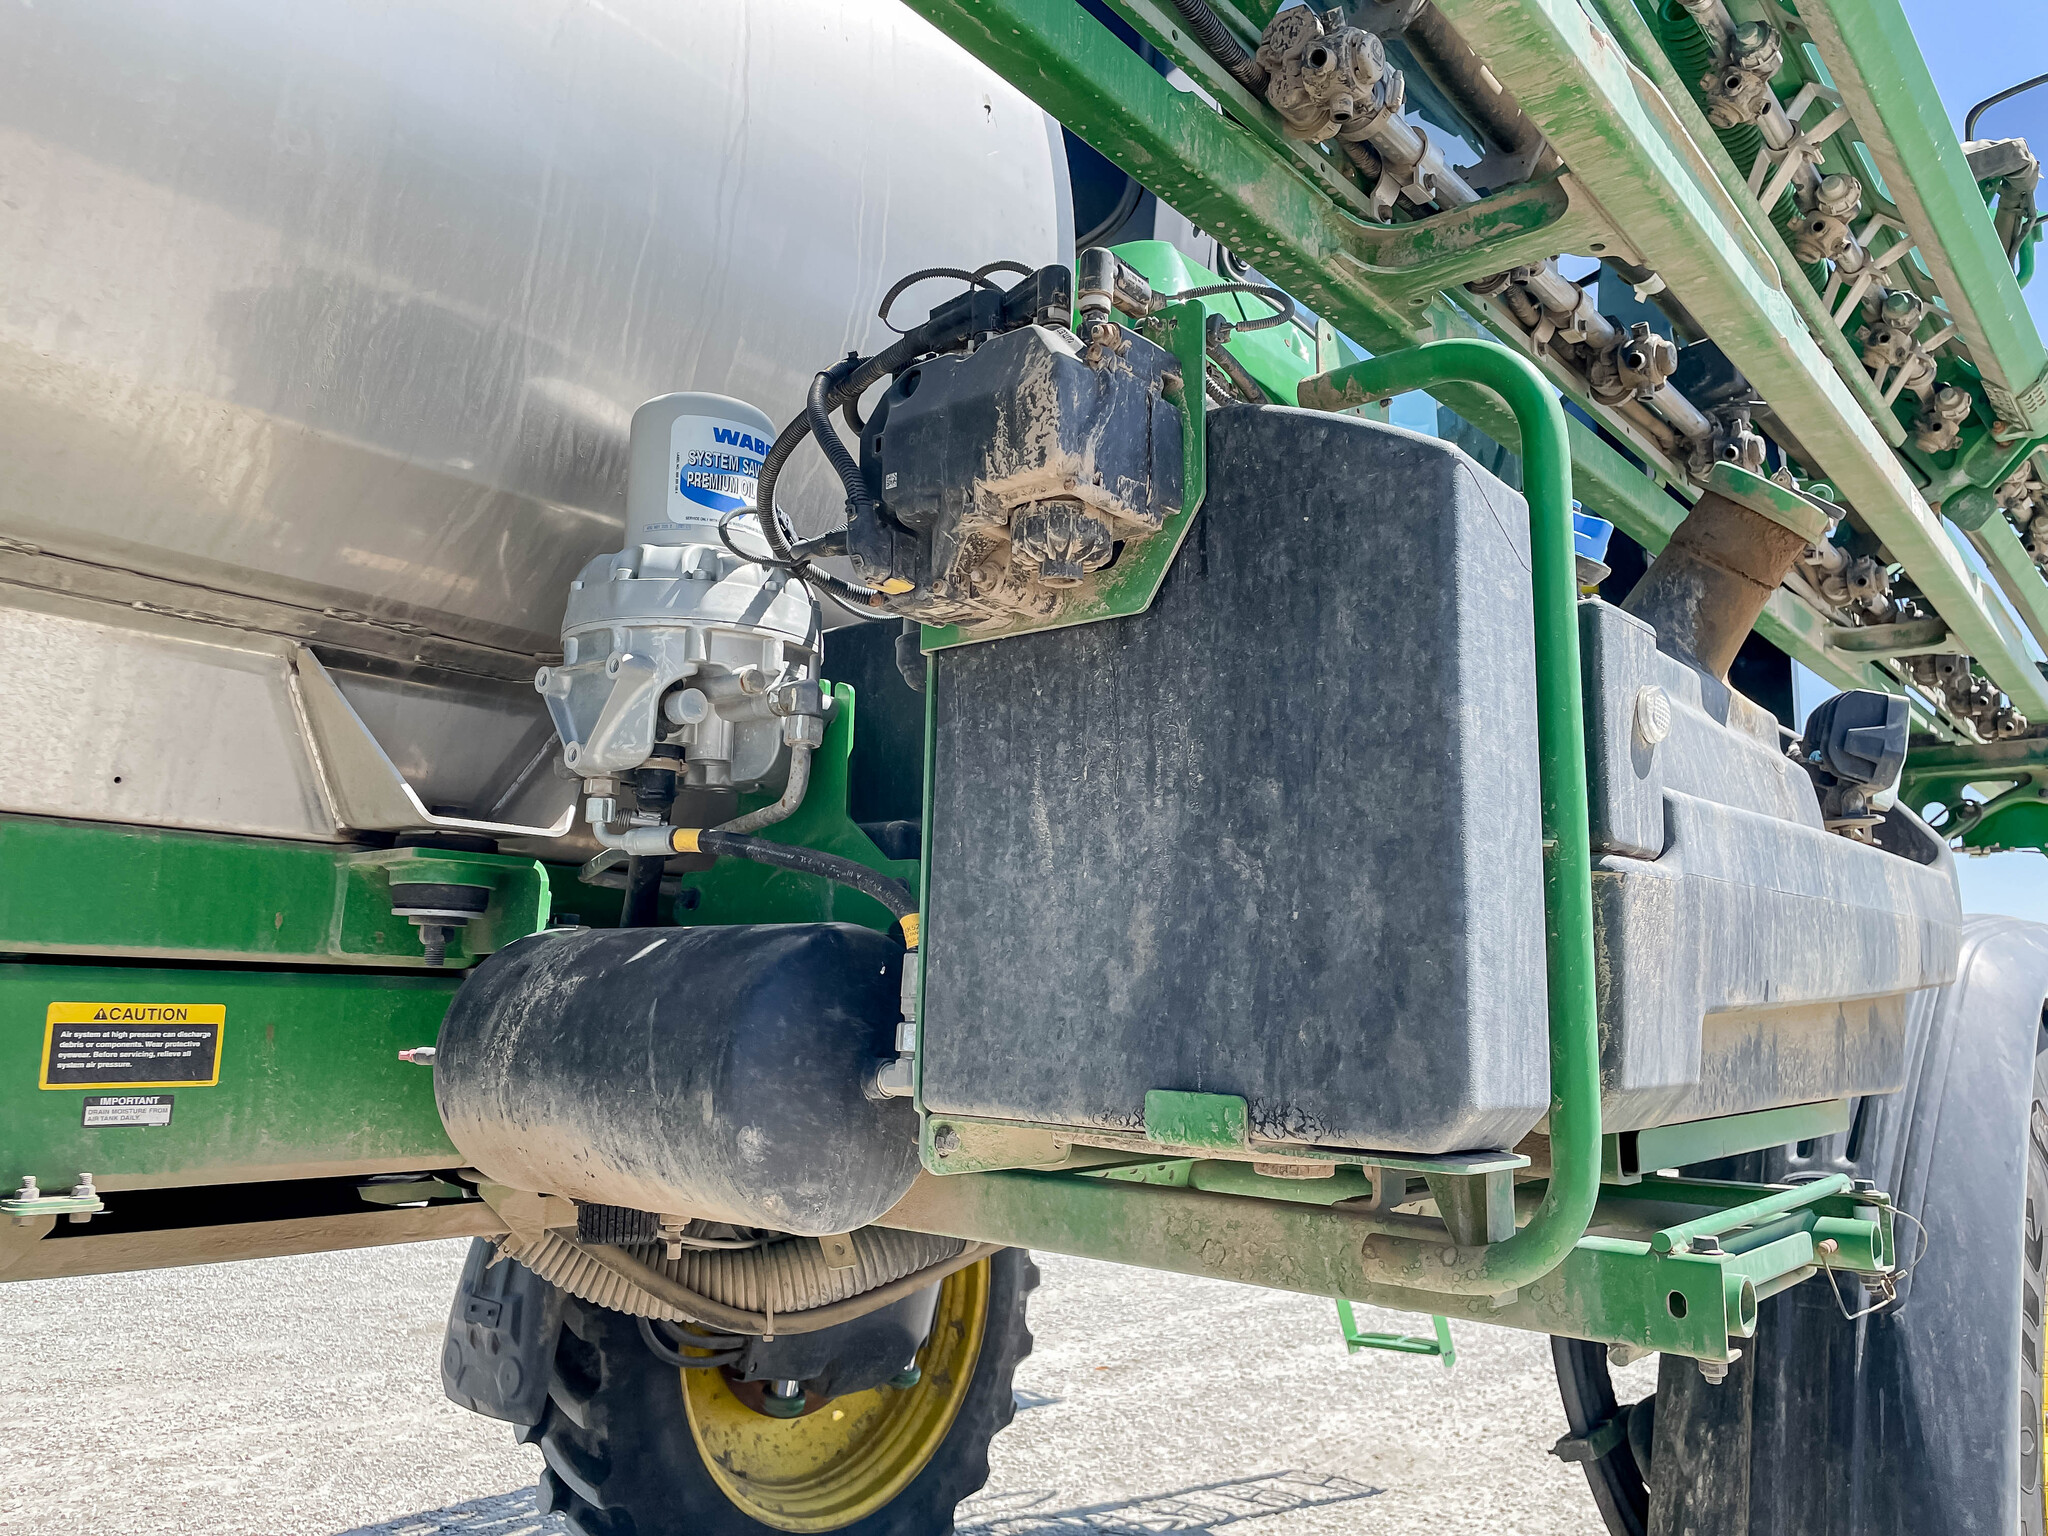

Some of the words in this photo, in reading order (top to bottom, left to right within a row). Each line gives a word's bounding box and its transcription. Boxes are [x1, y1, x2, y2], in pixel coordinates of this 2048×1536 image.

[688, 450, 740, 473] SYSTEM
[742, 459, 763, 479] SAV
[686, 471, 740, 496] PREMIUM
[741, 479, 757, 500] OIL
[109, 1007, 187, 1020] CAUTION
[73, 1031, 101, 1039] system
[111, 1031, 127, 1039] high
[177, 1031, 211, 1039] discharge
[95, 1041, 144, 1049] components.
[164, 1041, 200, 1049] protective
[57, 1052, 91, 1060] eyewear.
[119, 1050, 156, 1059] servicing,
[56, 1062, 85, 1070] system
[97, 1062, 133, 1070] pressure.
[100, 1097, 160, 1105] IMPORTANT
